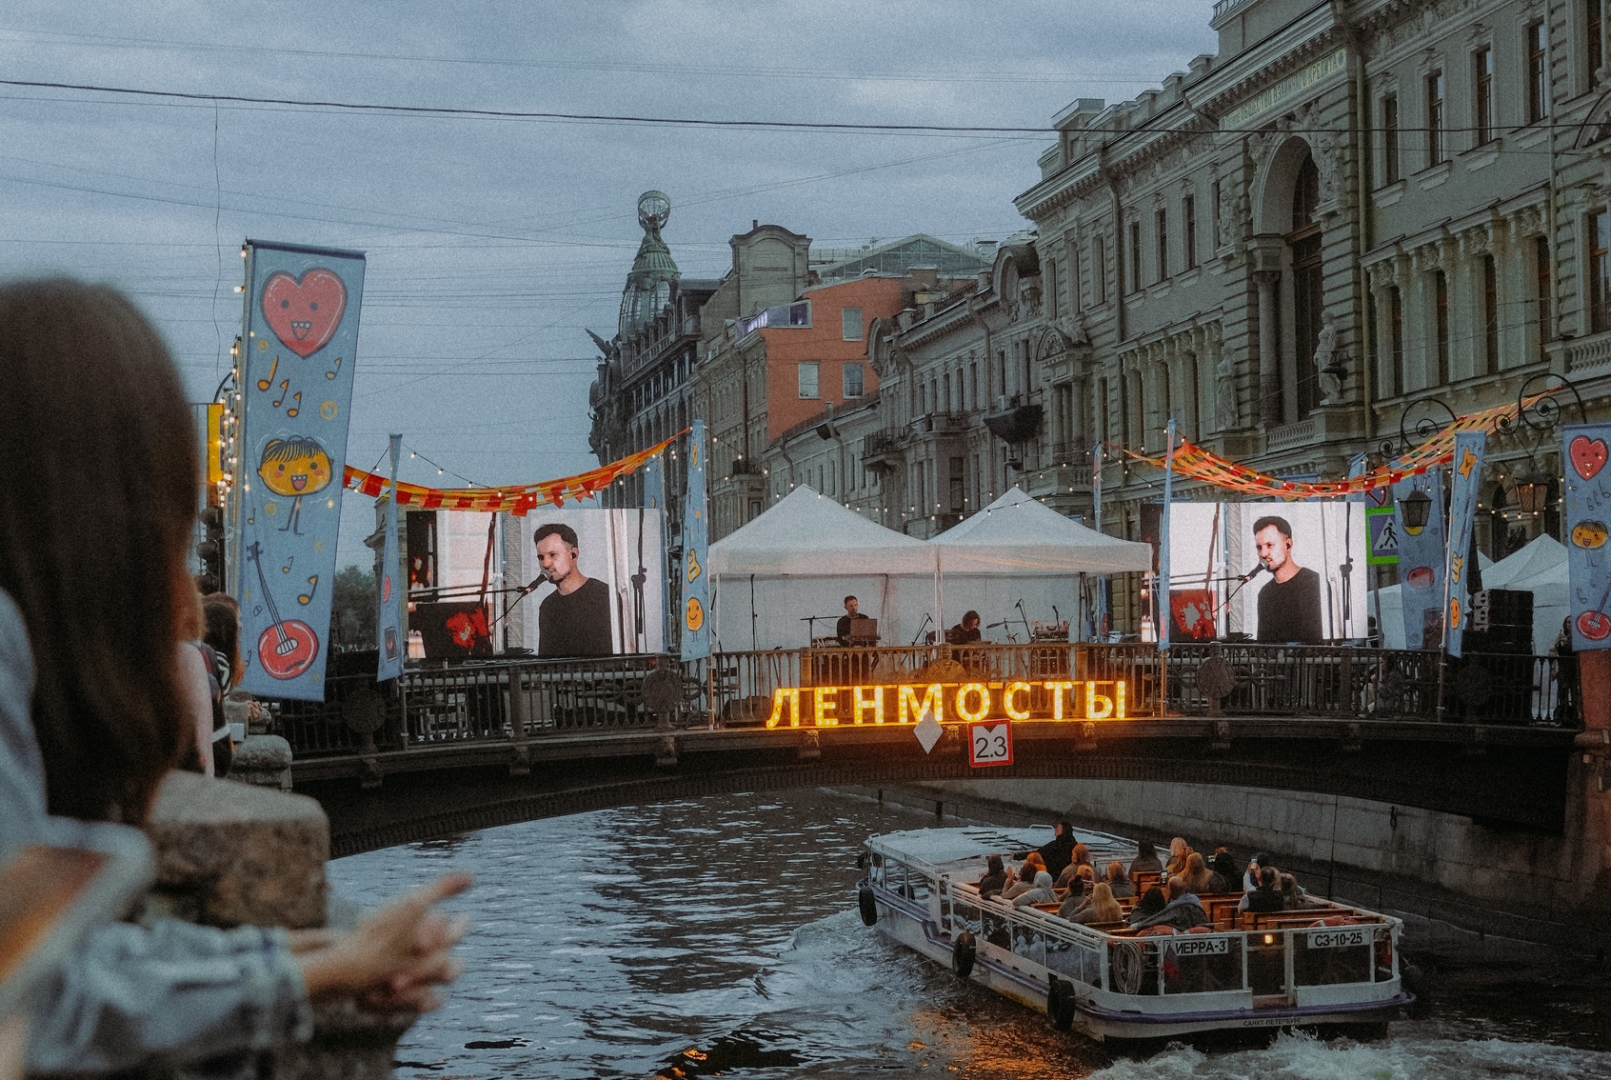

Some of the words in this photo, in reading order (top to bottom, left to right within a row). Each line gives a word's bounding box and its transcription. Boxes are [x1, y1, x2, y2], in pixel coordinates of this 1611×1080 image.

[766, 681, 1125, 728] ЛЕНМОСТЫ
[975, 736, 1007, 758] 2.3
[1175, 941, 1227, 954] ИЕРРА-3
